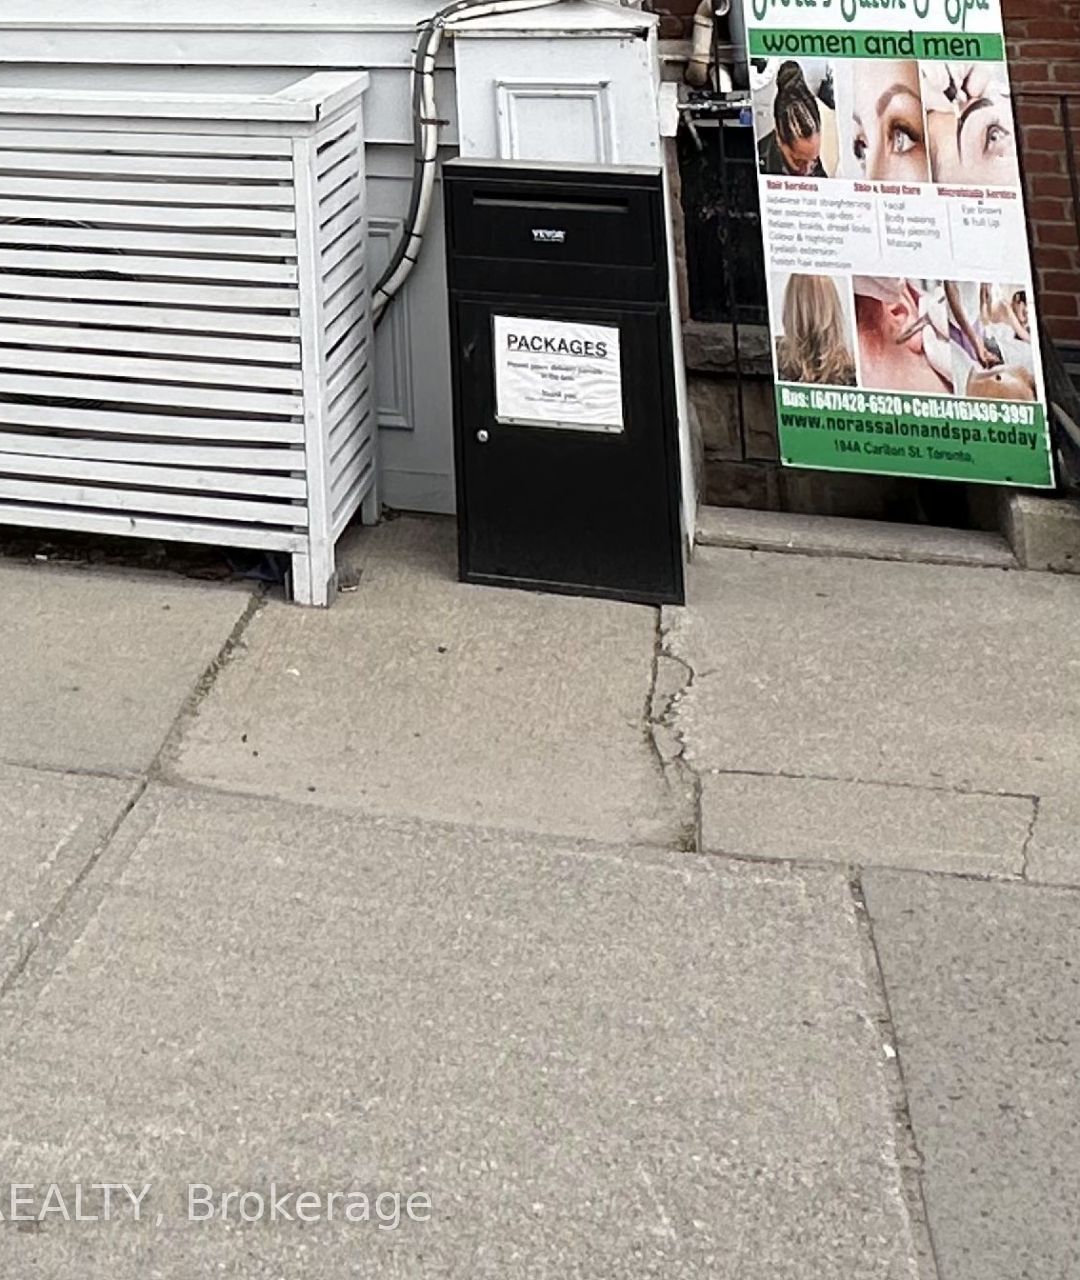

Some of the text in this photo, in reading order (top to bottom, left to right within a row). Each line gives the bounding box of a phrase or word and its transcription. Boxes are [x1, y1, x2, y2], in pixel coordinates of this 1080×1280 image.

[762, 30, 981, 57] women and men
[507, 333, 608, 358] PACKAGES
[781, 413, 1038, 451] www.norassalonandspa.today
